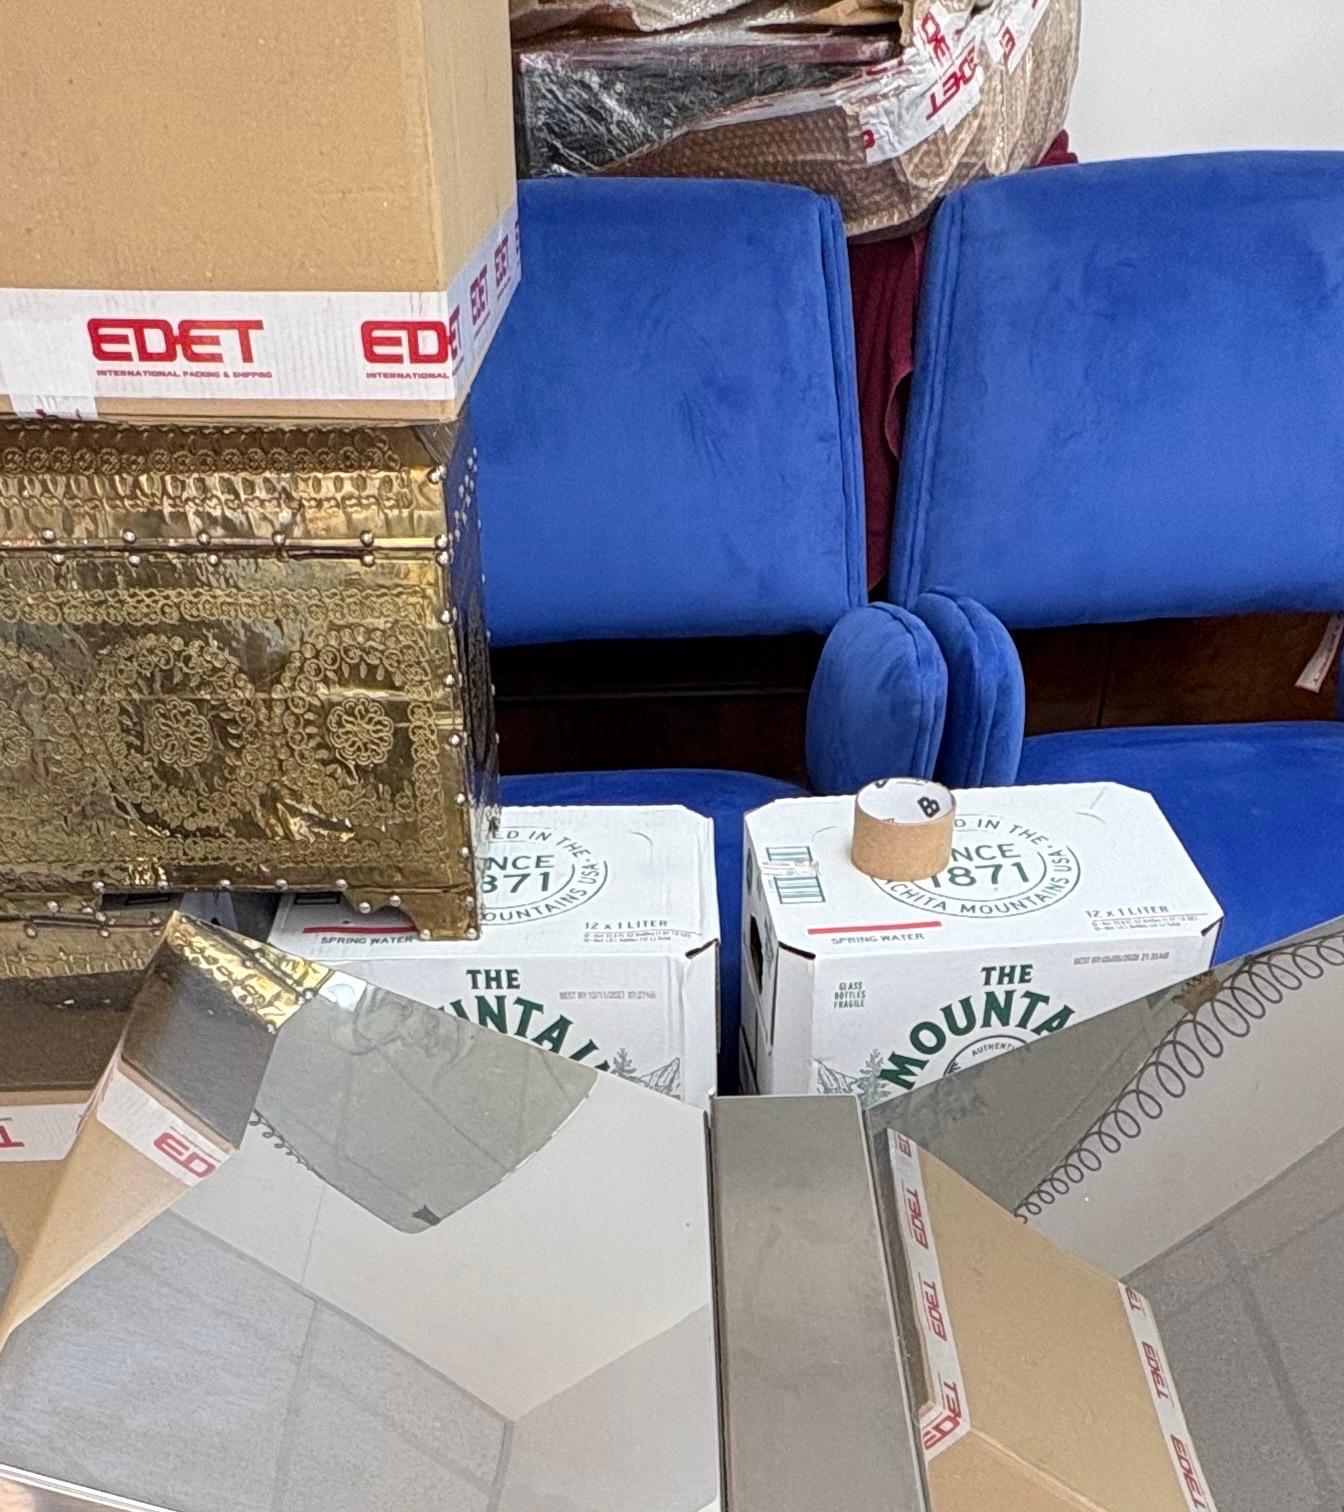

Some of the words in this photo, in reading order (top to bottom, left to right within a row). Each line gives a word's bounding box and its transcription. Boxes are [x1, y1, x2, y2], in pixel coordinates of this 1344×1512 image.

[87, 318, 264, 364] EDET
[96, 369, 181, 378] INTERNATIONAL
[366, 372, 450, 380] INTERNATIONAL
[978, 819, 1000, 829] IN
[1009, 823, 1049, 843] THE
[528, 830, 552, 842] IN
[557, 836, 591, 859] THE
[951, 843, 1022, 862] NCE
[486, 855, 556, 871] NCE
[885, 878, 947, 912] CHITA
[959, 875, 1072, 915] MOUNTAINS
[1050, 847, 1073, 875] USA
[481, 888, 589, 922] OUNTAINS
[578, 862, 600, 886] USA
[1086, 910, 1100, 918] 12
[1118, 908, 1125, 916] 1
[1128, 905, 1169, 916] LITER
[585, 921, 599, 930] 12
[617, 921, 623, 930] 1
[627, 920, 669, 930] LITER
[321, 935, 368, 945] SPRING
[369, 934, 414, 945] WATER
[831, 935, 877, 945] SPRING
[880, 933, 925, 943] WATER
[466, 968, 522, 990] THE
[980, 963, 1034, 987] THE
[839, 981, 863, 991] GLASS
[834, 990, 866, 1000] BOTTLES
